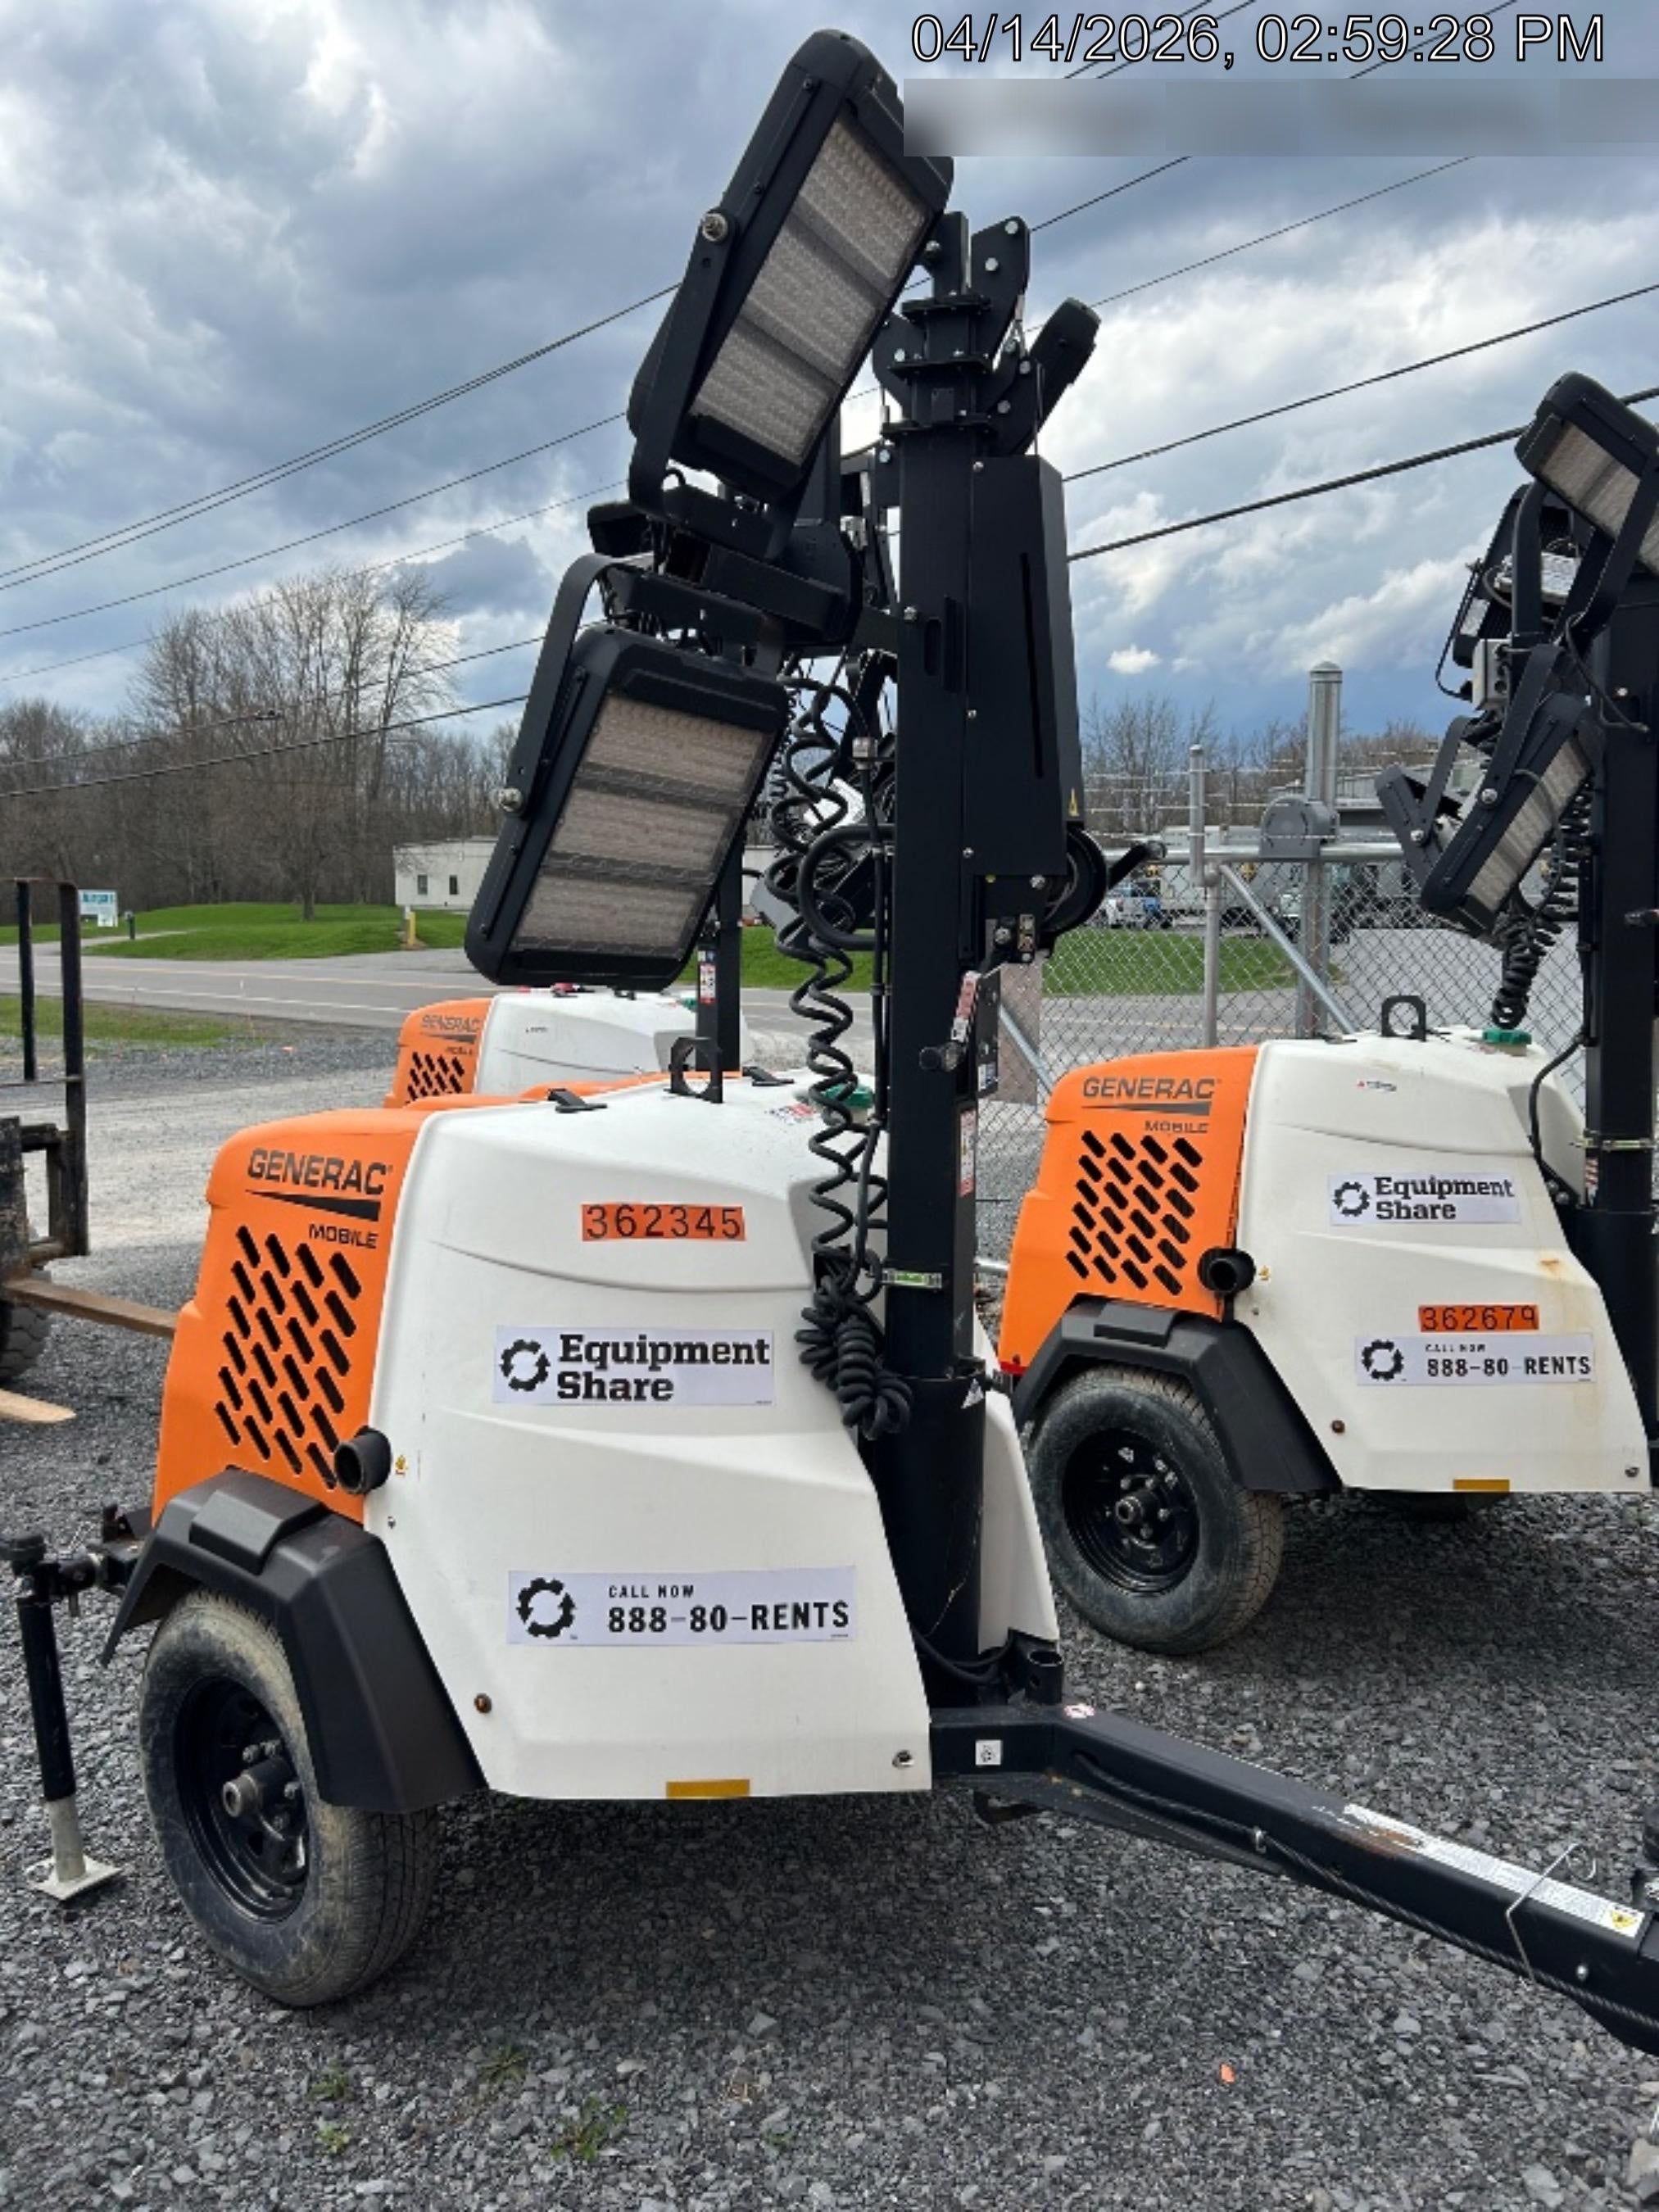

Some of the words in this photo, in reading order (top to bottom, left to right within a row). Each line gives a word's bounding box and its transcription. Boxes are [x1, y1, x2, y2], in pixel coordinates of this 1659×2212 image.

[1083, 1077, 1215, 1099] GENERAC
[1145, 1121, 1209, 1134] MOBILE
[247, 1147, 387, 1195] GENERAC
[1374, 1175, 1515, 1200] Equipment
[586, 1203, 741, 1239] 362345
[1376, 1200, 1457, 1220] Share
[308, 1223, 378, 1249] MOBILE
[1422, 1305, 1536, 1330] 362679
[559, 1334, 771, 1372] Equipment
[1426, 1355, 1592, 1377] 888-80-RENTS
[557, 1371, 674, 1402] Share
[609, 1584, 650, 1598] CALL
[657, 1584, 695, 1598] NOW
[608, 1600, 850, 1633] 888-80-RENTS
